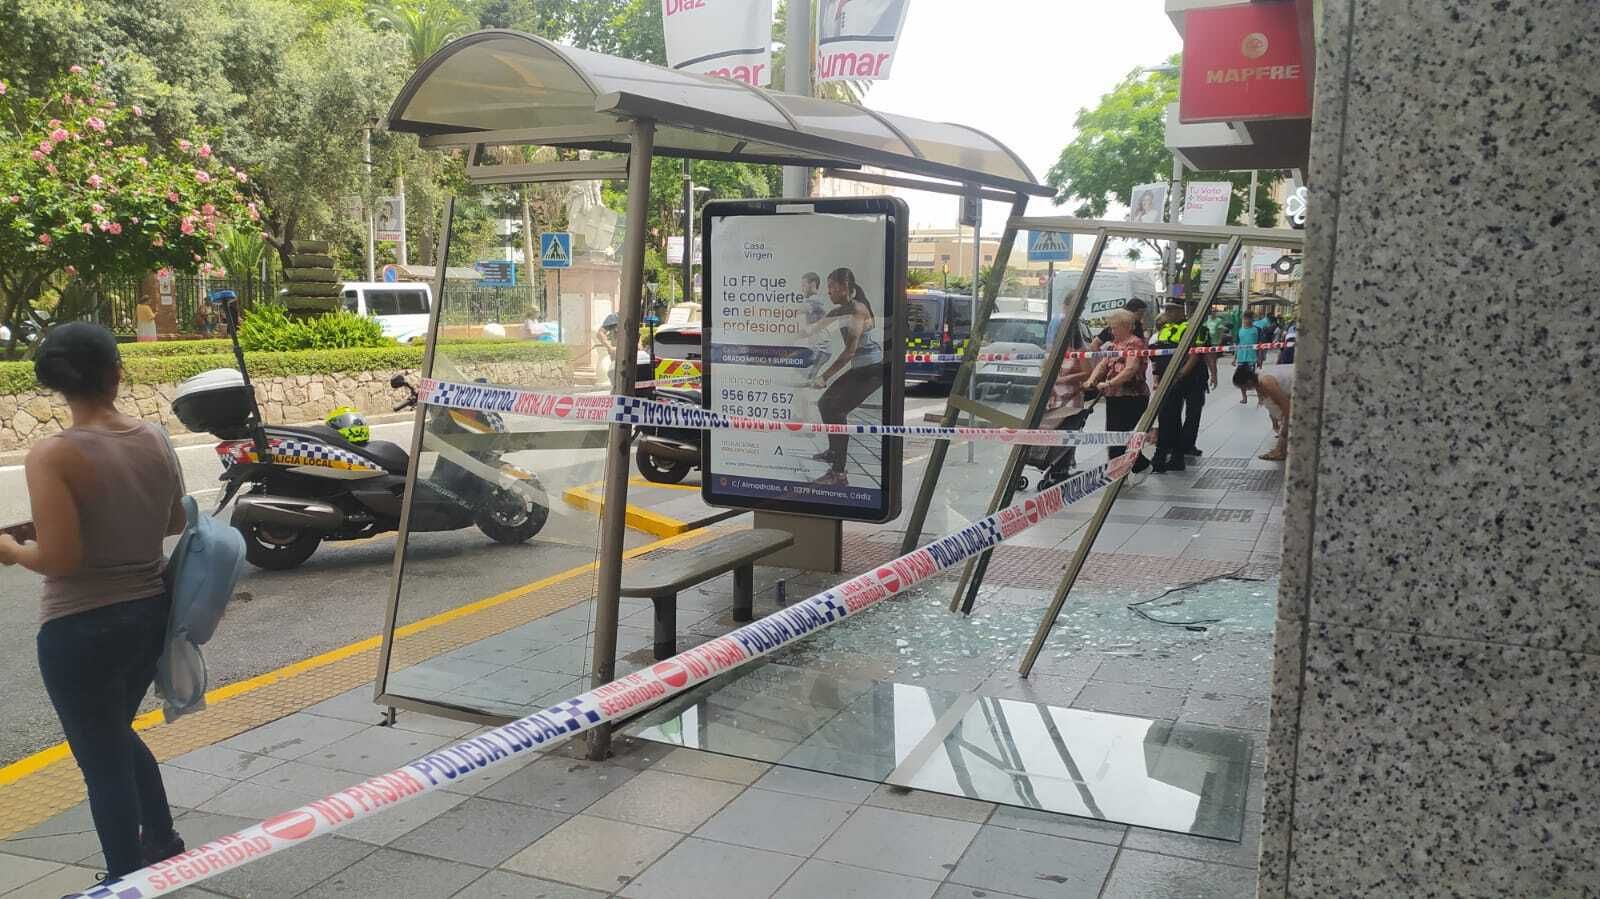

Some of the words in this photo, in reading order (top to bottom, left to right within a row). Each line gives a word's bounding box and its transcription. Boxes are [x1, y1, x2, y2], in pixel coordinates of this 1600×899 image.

[1206, 64, 1301, 85] MAPFRE
[744, 241, 765, 250] Casa
[744, 250, 773, 260] Virgen
[723, 275, 738, 287] La
[741, 275, 756, 287] FP
[760, 278, 787, 291] que
[723, 291, 736, 302] te
[740, 291, 804, 303] convierte
[1094, 299, 1124, 311] ACEBO
[722, 306, 739, 317] en
[743, 305, 755, 317] el
[759, 307, 799, 321] mejor
[723, 320, 800, 335] profesional
[452, 385, 481, 408] LOCAL
[480, 388, 517, 412] POLICIA
[721, 389, 744, 401] 956
[747, 390, 768, 402] 677
[771, 392, 794, 404] 657
[641, 402, 680, 426] LOCAL
[747, 406, 769, 418] 307
[772, 408, 791, 420] 531
[270, 455, 300, 465] OLICIA
[303, 457, 333, 467] LOCAL
[927, 535, 967, 570] POLICIA
[961, 524, 989, 555] LOCAL
[895, 558, 914, 586] NO
[906, 549, 937, 581] PASAR
[845, 585, 886, 612] SEGURIDAD
[735, 618, 793, 656] POLICIA
[786, 601, 827, 635] LOCAL
[676, 653, 710, 679] NO
[694, 637, 746, 672] PASAR
[593, 679, 628, 699] LINEA
[628, 673, 648, 685] DE
[600, 681, 666, 716] SEGURIDAD
[411, 736, 509, 784] POLICIA
[493, 713, 567, 753] LOCAL
[306, 795, 356, 825] NO
[348, 770, 425, 813] PASAR
[147, 836, 273, 890] SEGURIDAD
